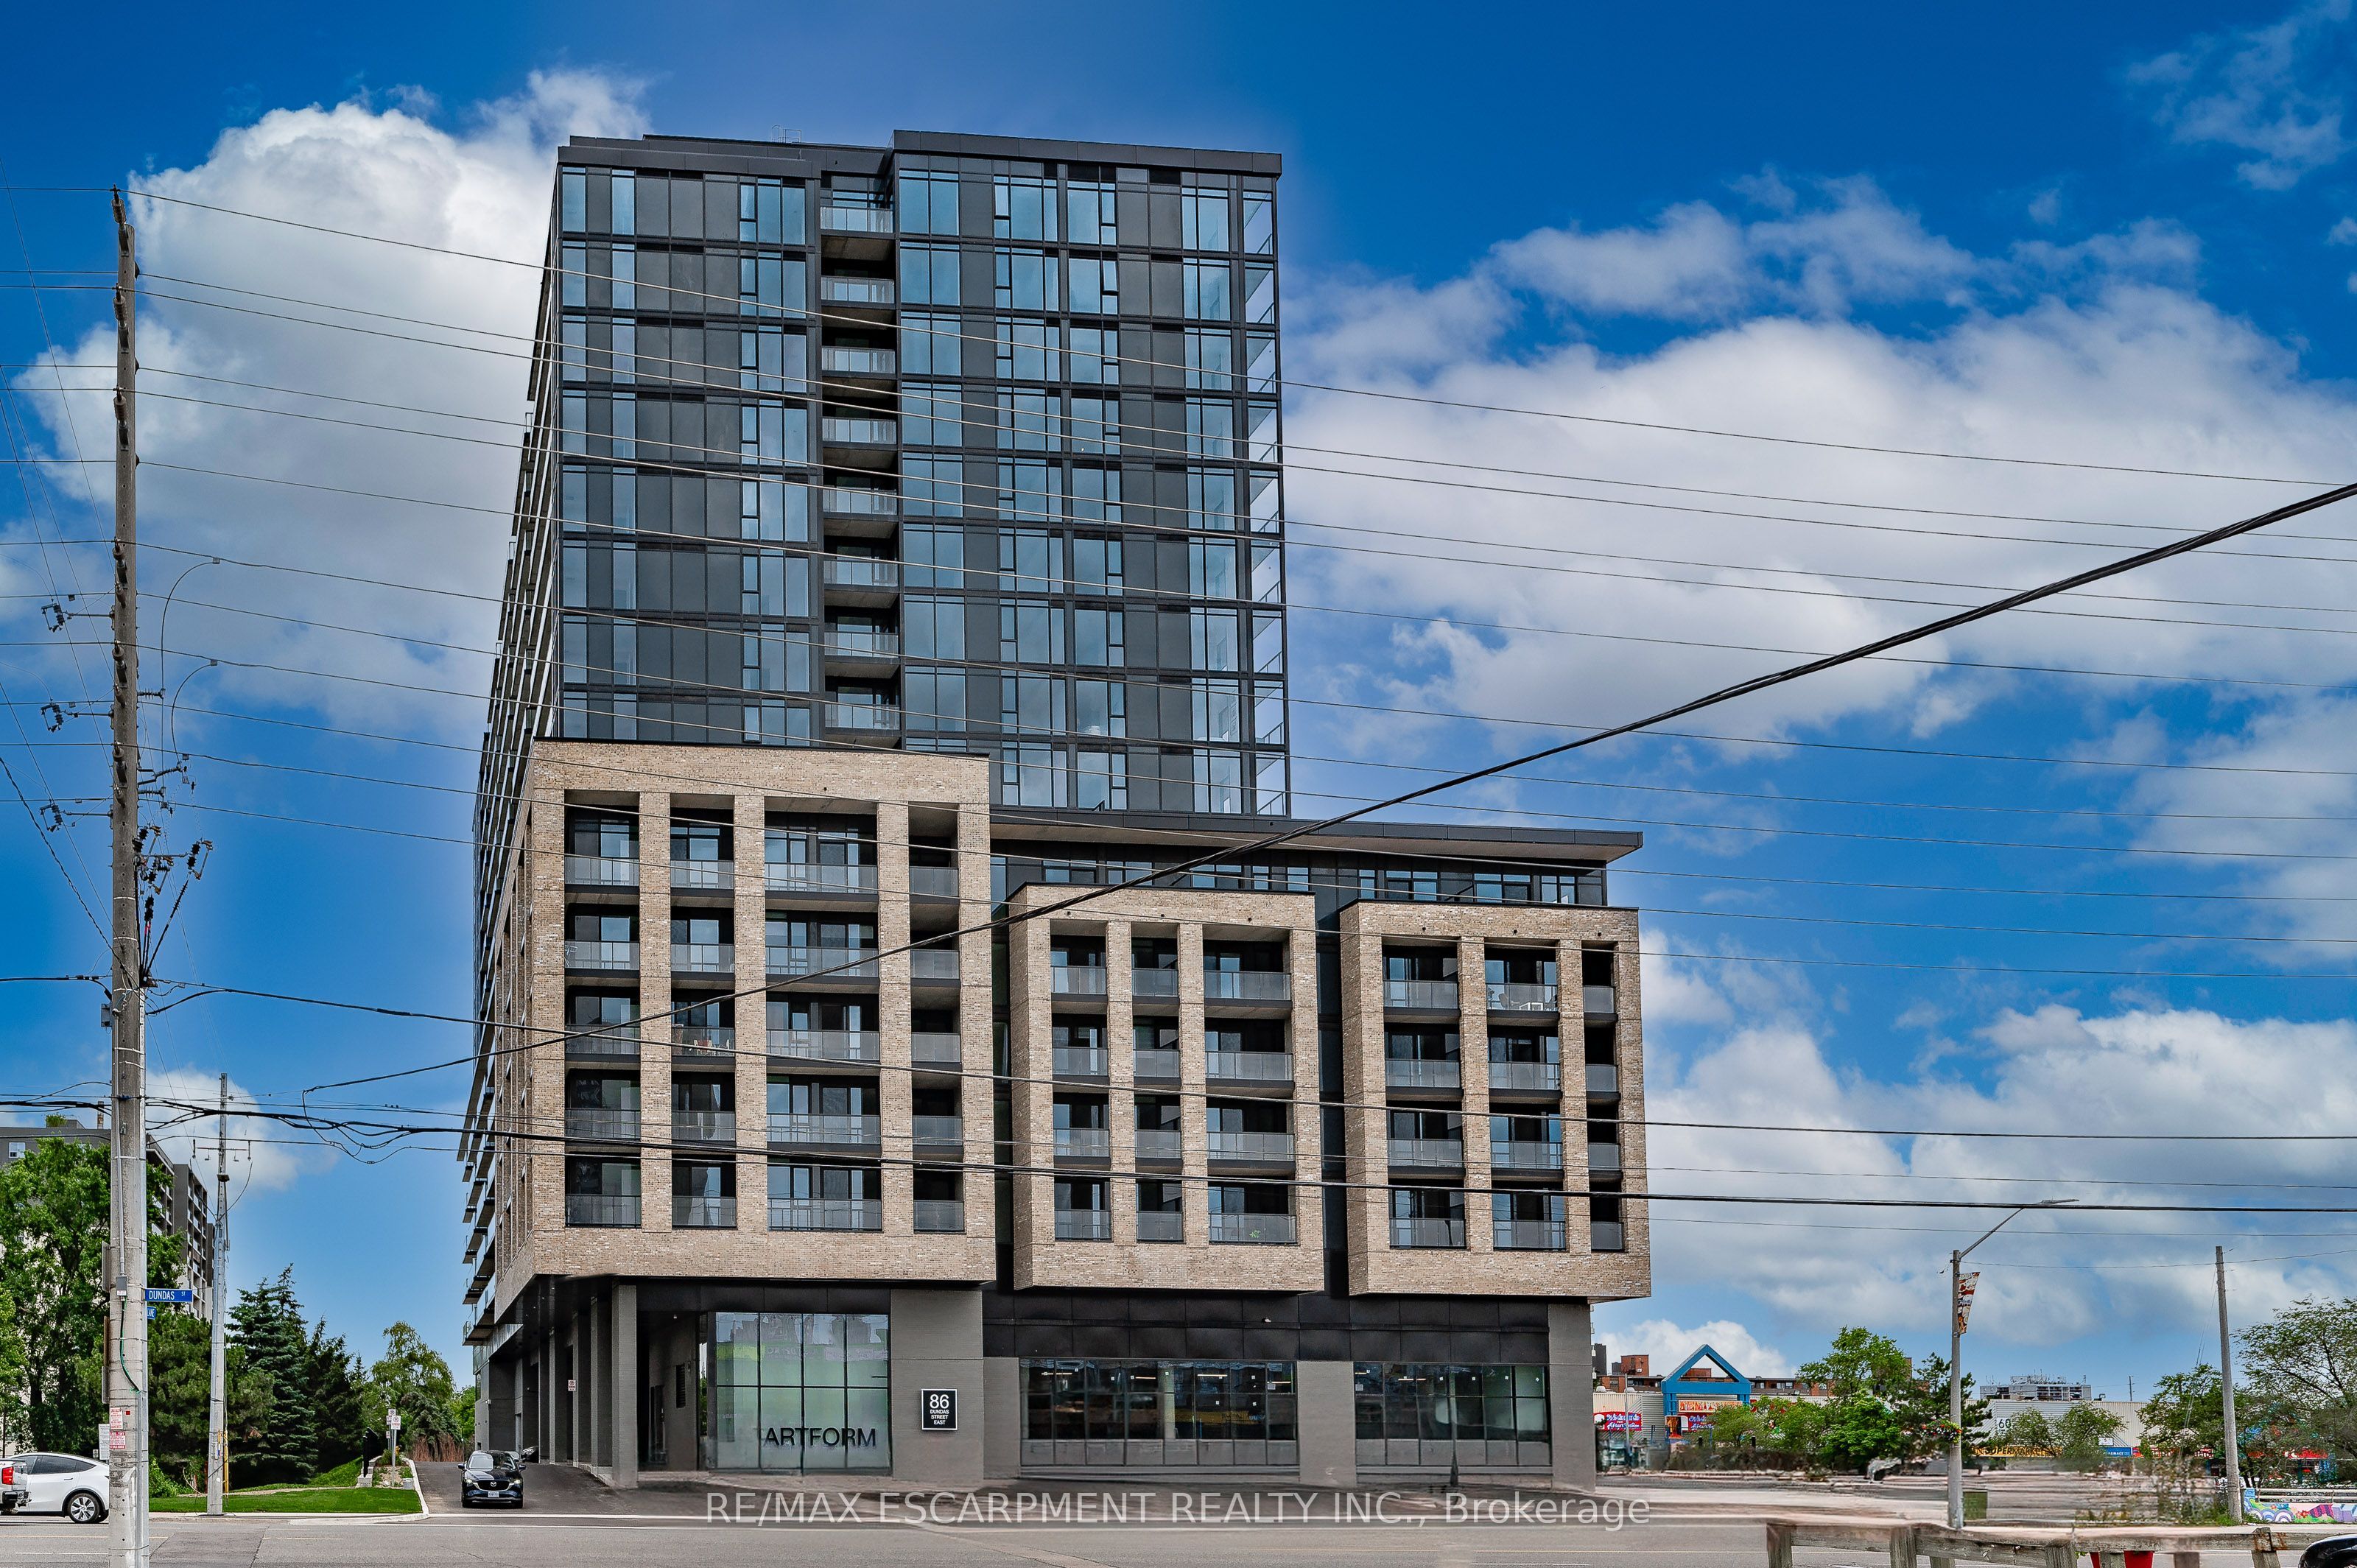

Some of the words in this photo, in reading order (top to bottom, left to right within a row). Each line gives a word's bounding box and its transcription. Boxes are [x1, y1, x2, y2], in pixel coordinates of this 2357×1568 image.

[149, 1290, 175, 1301] DUNDAS
[930, 1393, 949, 1409] 86
[1998, 1418, 2011, 1429] 60
[763, 1427, 877, 1446] ARTFORM
